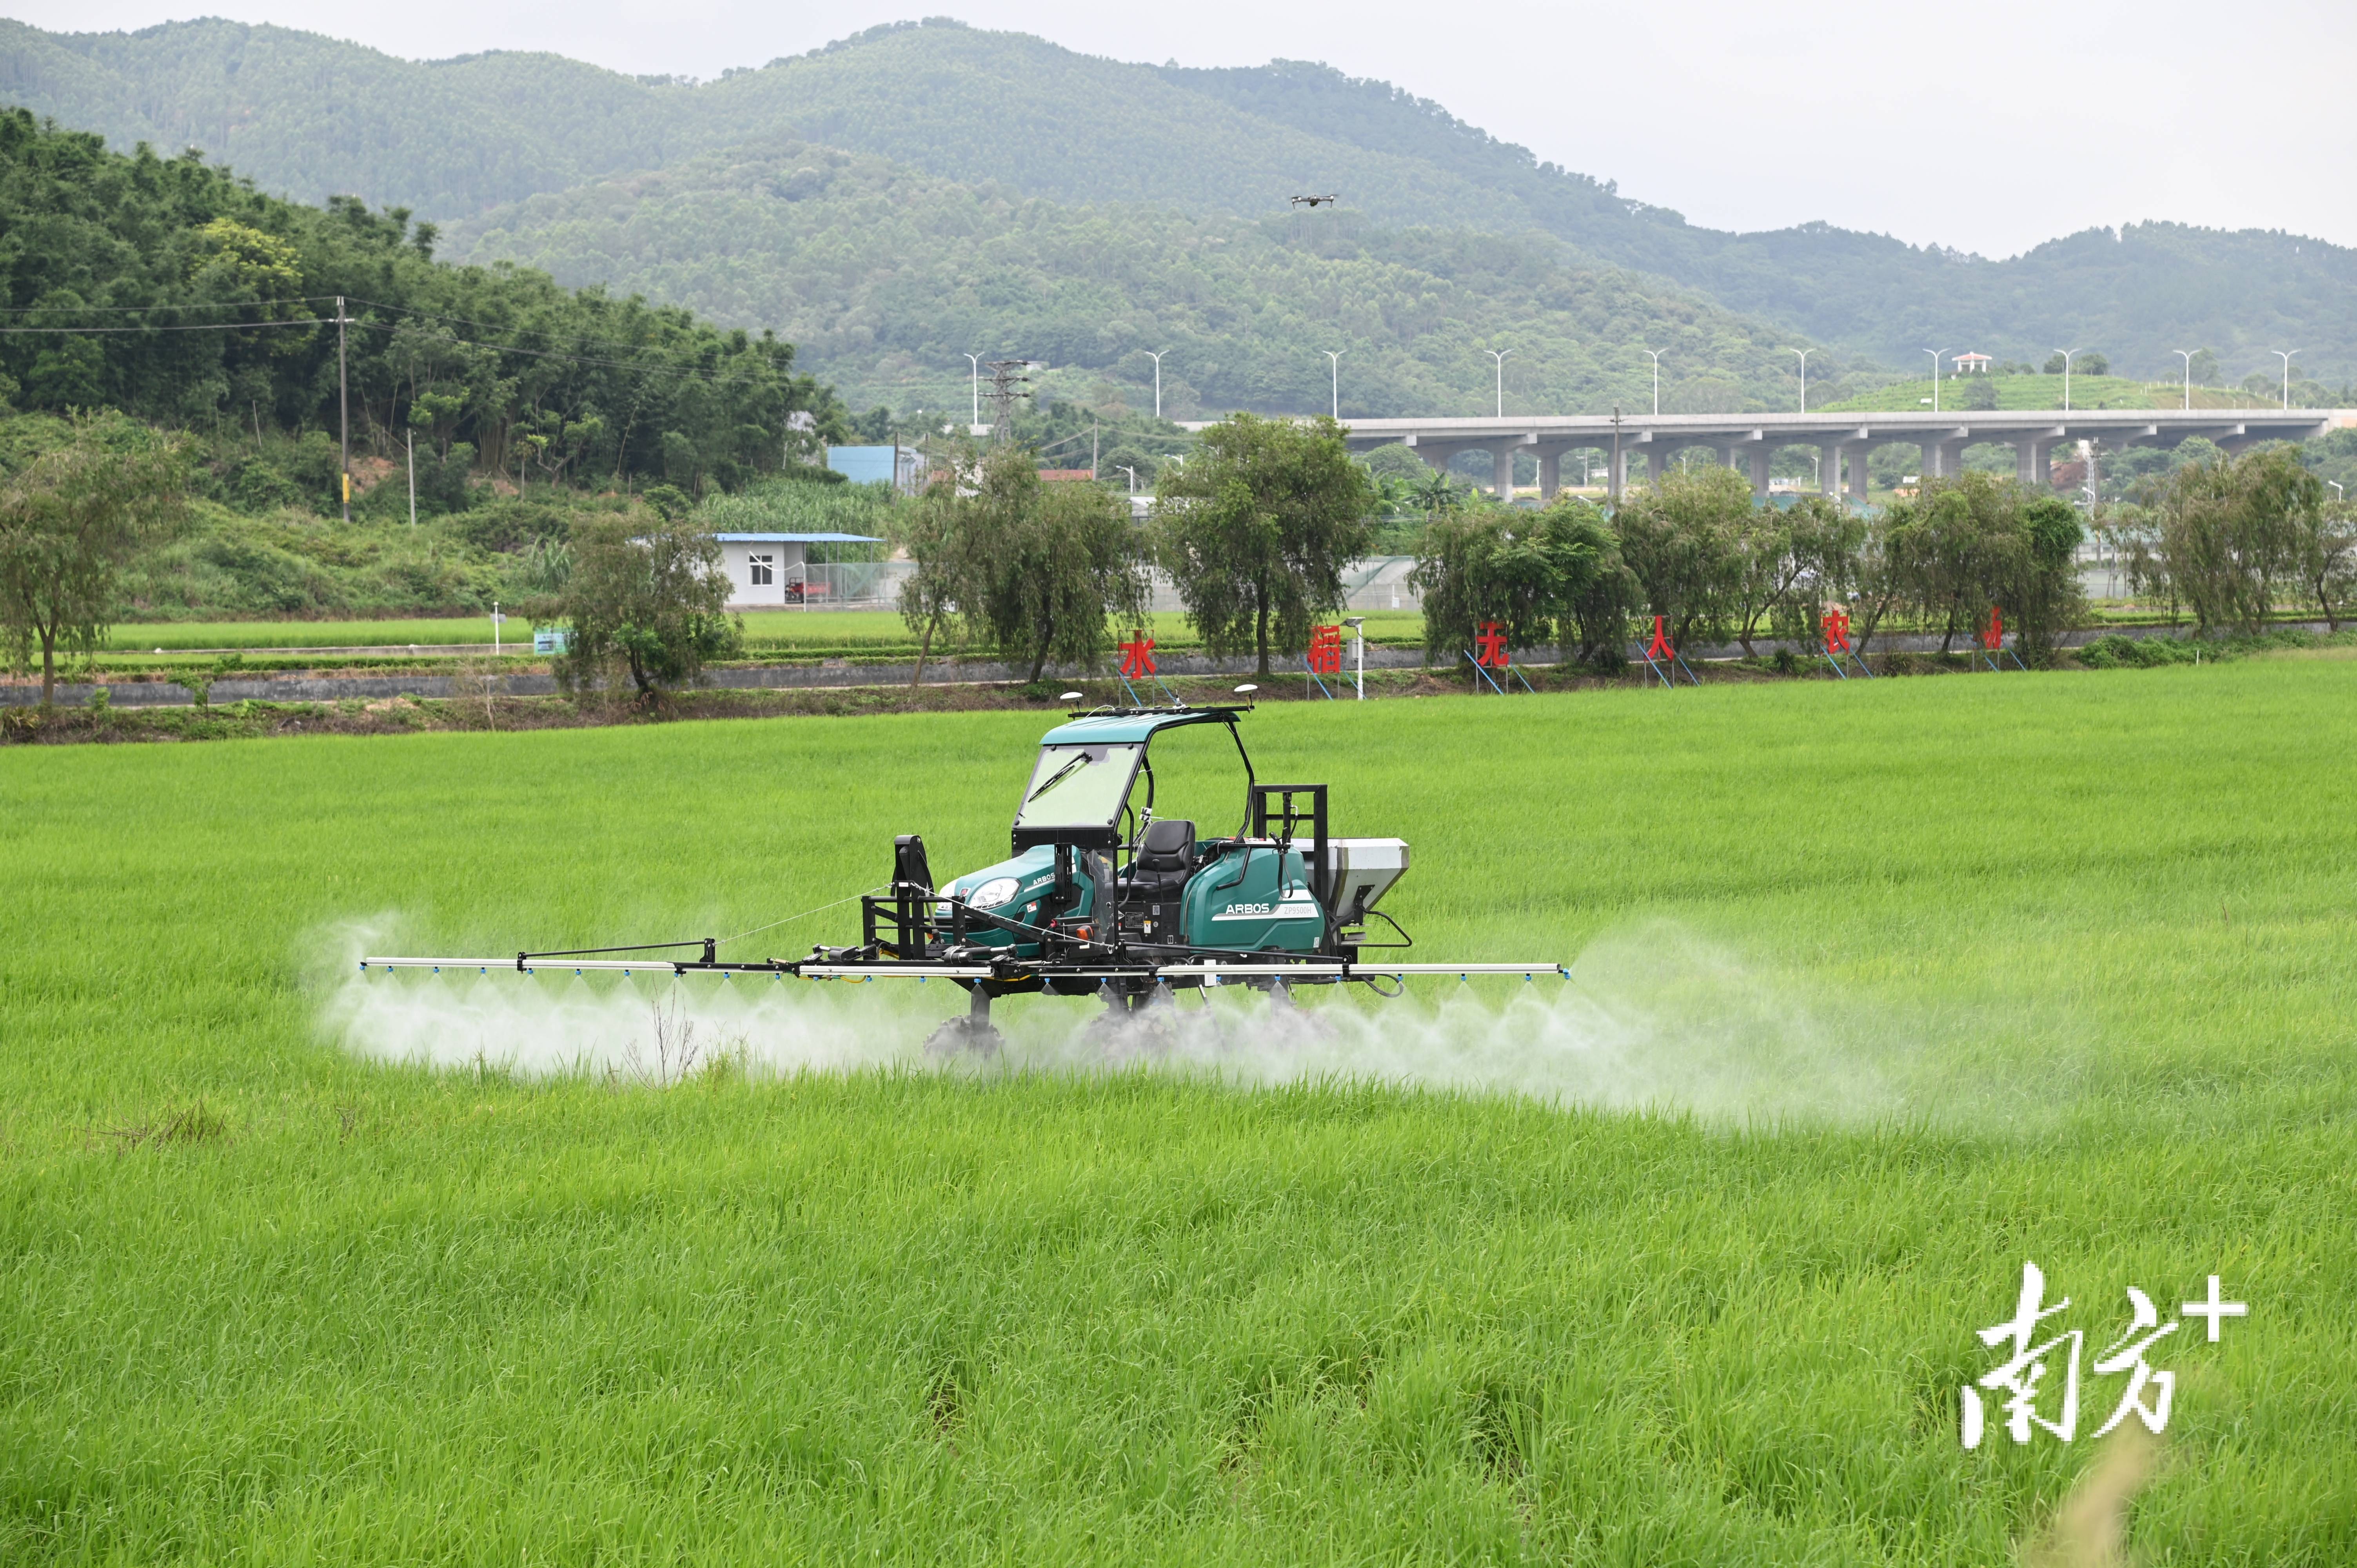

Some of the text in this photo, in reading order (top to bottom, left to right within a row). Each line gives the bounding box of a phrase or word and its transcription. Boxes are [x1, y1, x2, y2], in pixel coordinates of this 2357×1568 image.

[1120, 630, 1157, 679] 水
[1645, 615, 1674, 661] 人
[1033, 872, 1055, 886] ARBOS
[1226, 903, 1312, 915] ARBOS ZP9500H
